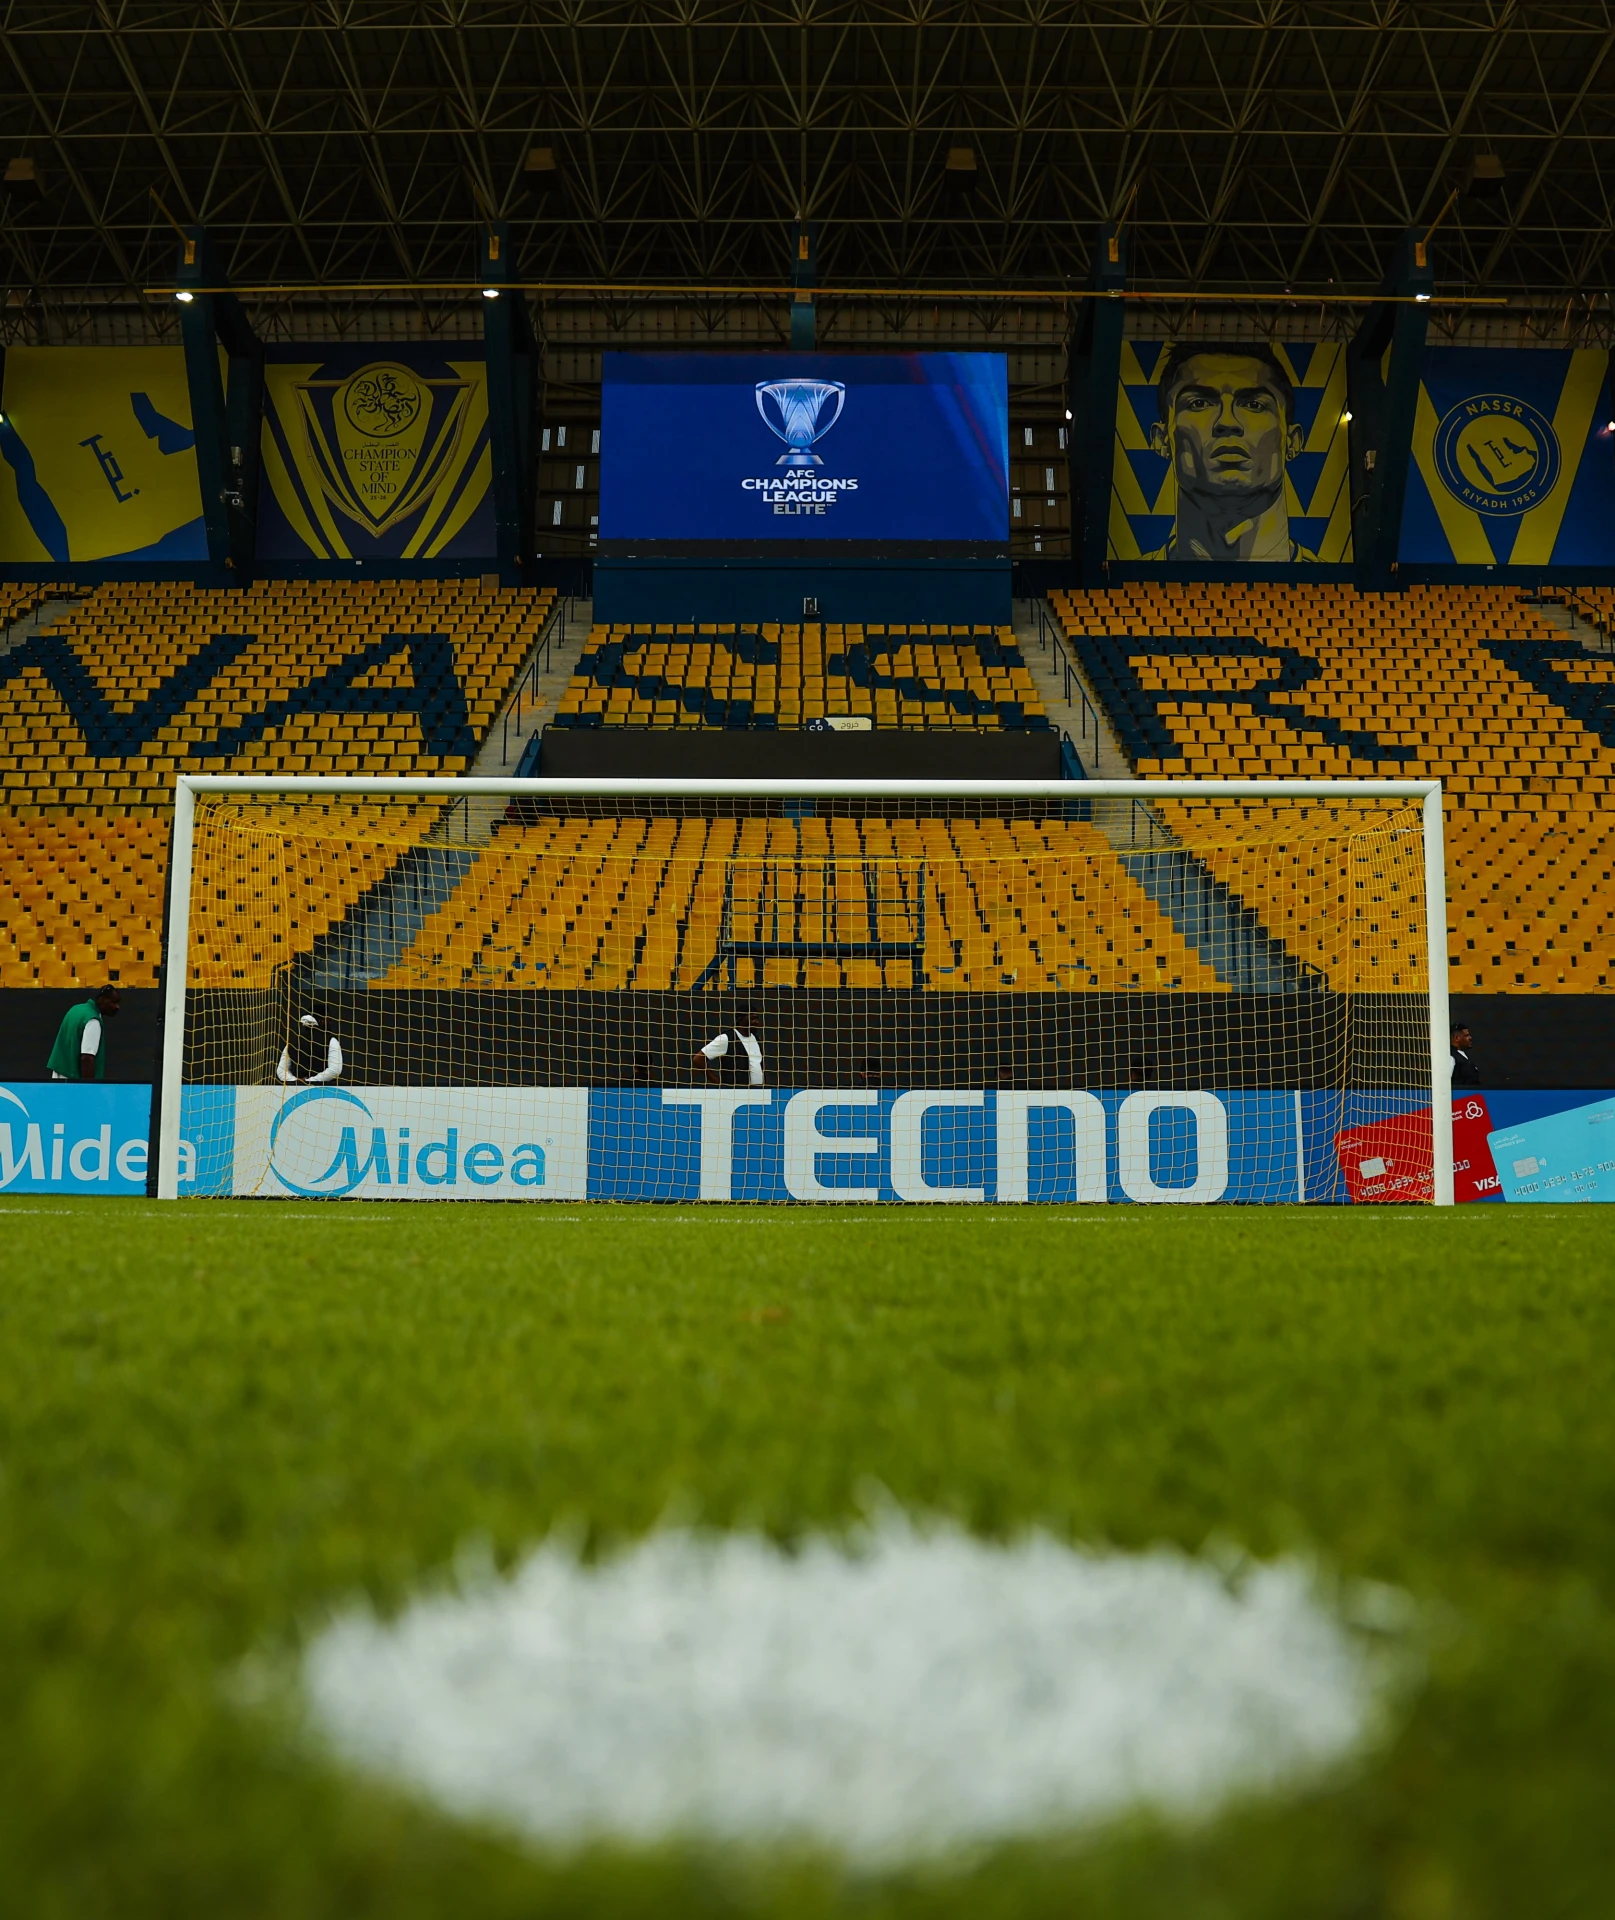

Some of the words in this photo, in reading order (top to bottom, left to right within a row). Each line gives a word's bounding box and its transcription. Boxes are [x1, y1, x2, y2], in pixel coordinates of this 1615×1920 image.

[1465, 400, 1524, 417] NASSR
[344, 448, 417, 460] CHAMPION
[360, 460, 400, 471] STATE
[370, 471, 389, 483] OF
[785, 469, 815, 478] AFC
[361, 482, 397, 494] MIND
[741, 478, 859, 490] CHAMPIONS
[762, 491, 837, 502] LEAGUE
[1462, 487, 1507, 508] RIYADH
[1511, 489, 1536, 507] 1955
[773, 503, 826, 515] ELITE
[840, 721, 860, 730] خروج
[660, 1087, 1229, 1203] TECNO
[309, 1125, 546, 1189] Midea
[1360, 1183, 1386, 1197] 4000
[1388, 1176, 1414, 1190] 1234
[1417, 1168, 1434, 1182] 567
[1514, 1182, 1540, 1196] 4000
[1542, 1175, 1567, 1189] 1234
[1570, 1166, 1595, 1181] 5678
[1597, 1160, 1615, 1173] 901
